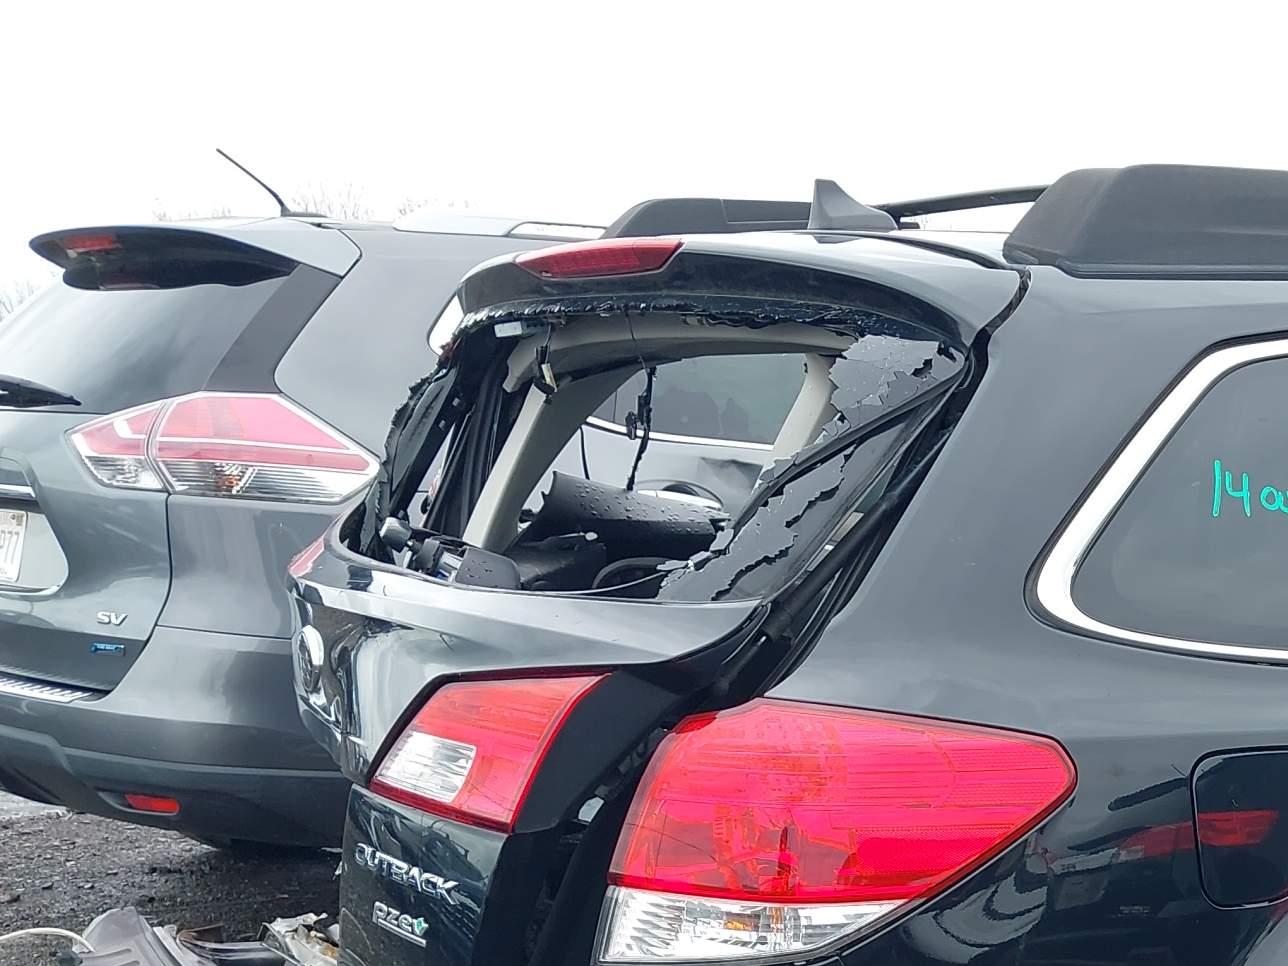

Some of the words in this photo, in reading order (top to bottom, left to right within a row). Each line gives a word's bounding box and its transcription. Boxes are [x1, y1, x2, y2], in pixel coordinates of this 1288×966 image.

[1212, 459, 1251, 517] 14
[96, 611, 128, 625] SV
[354, 842, 460, 905] OUTBACK
